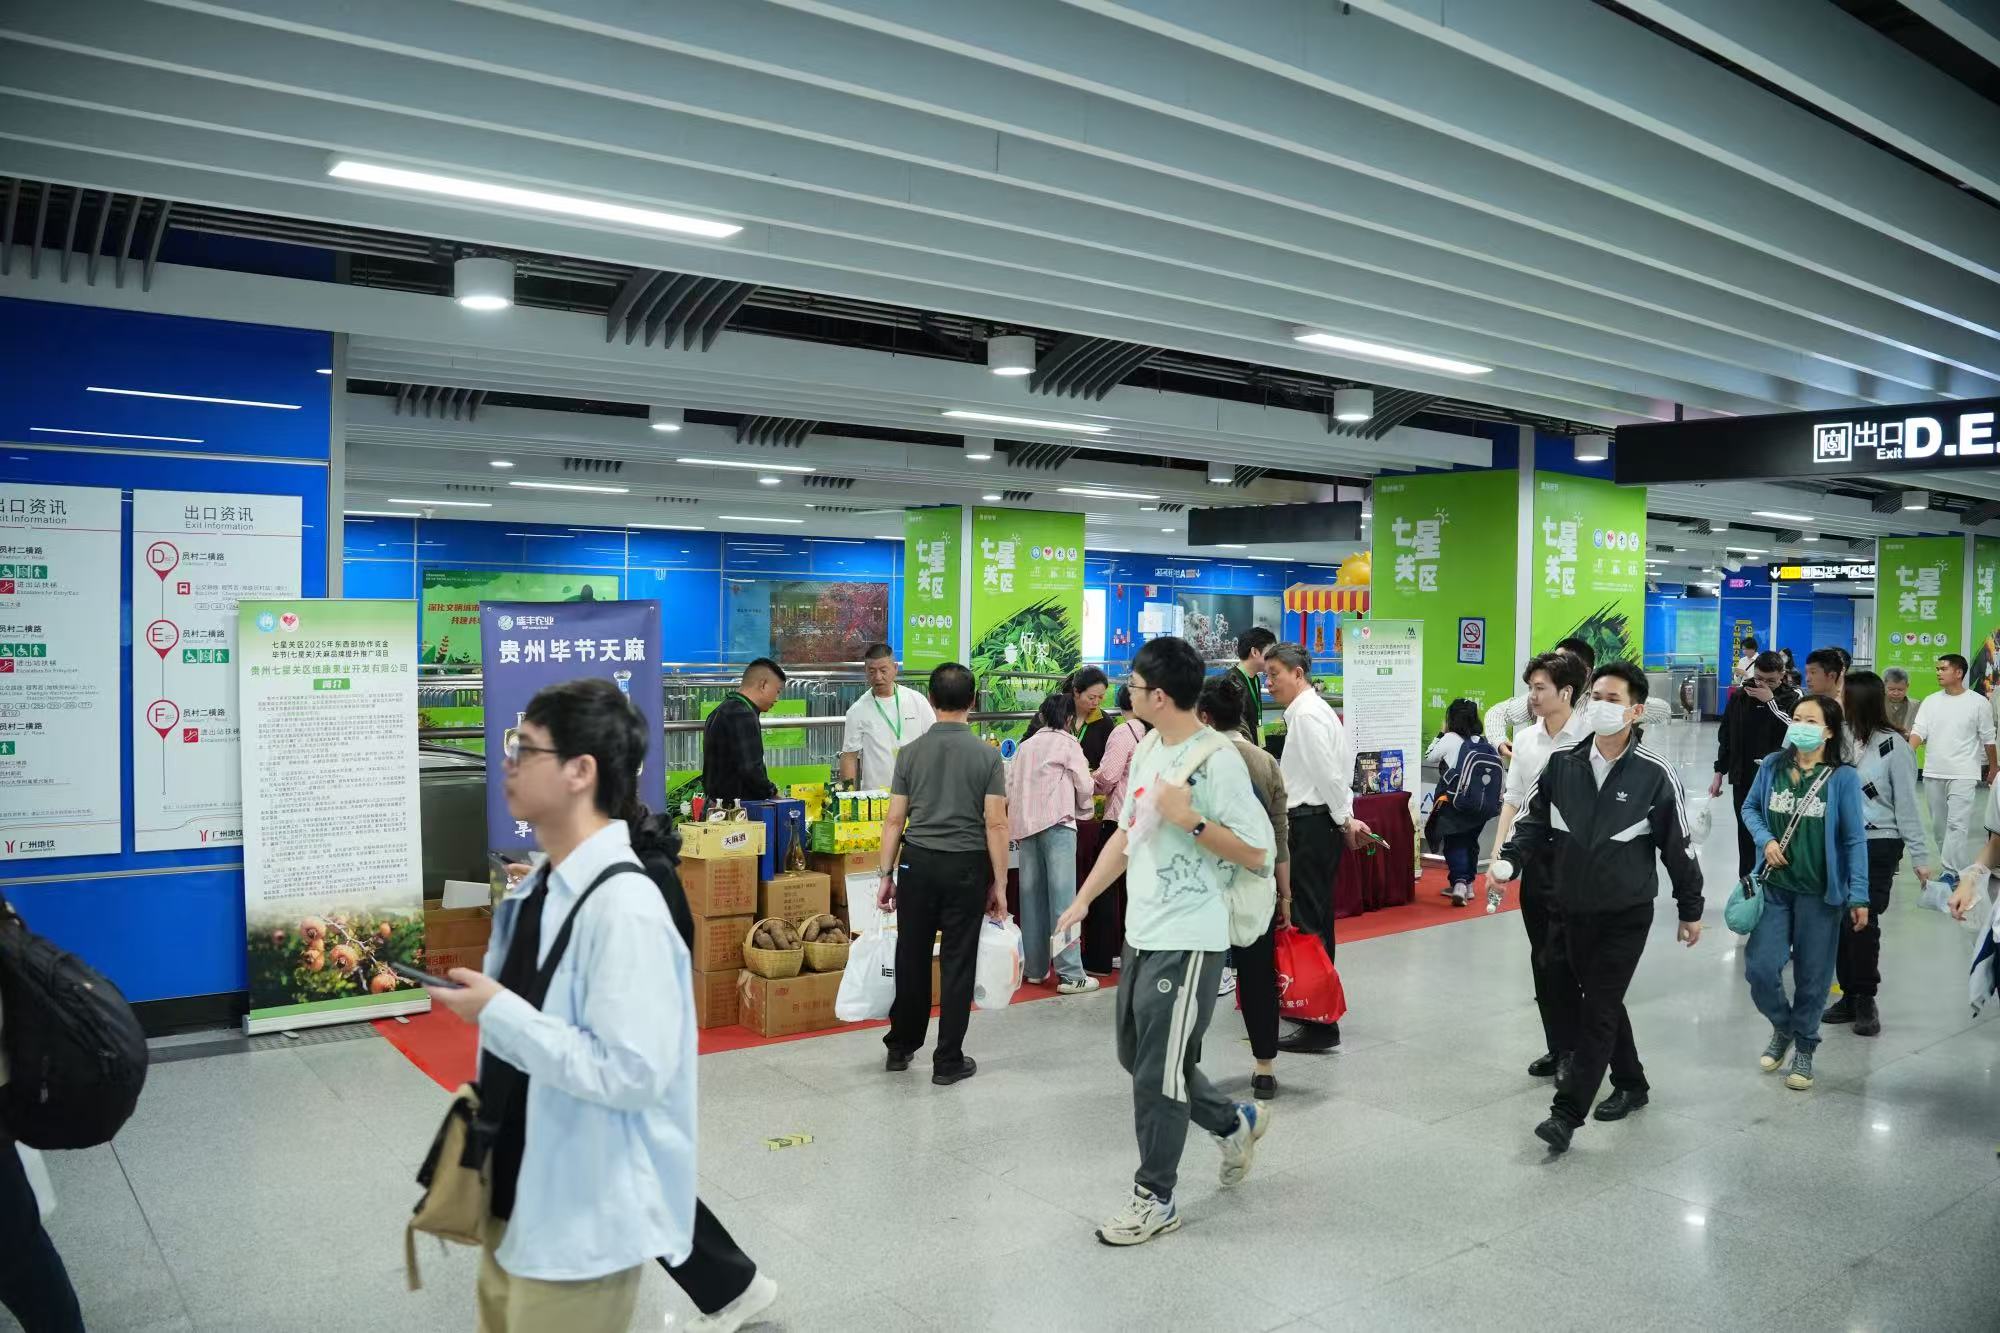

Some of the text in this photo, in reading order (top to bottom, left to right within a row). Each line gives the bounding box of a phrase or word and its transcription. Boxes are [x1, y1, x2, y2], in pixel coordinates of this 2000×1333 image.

[1855, 412, 2000, 459] 出口 D.E
[1876, 447, 1902, 460] Exit
[11, 514, 67, 524] Information
[184, 505, 254, 522] 出口资讯
[185, 521, 254, 531] Exit Information
[1392, 516, 1440, 560] 七星
[1542, 515, 1577, 562] 七星
[0, 546, 43, 555] 员村二横路
[152, 549, 165, 564] D
[182, 552, 225, 561] 员村二横路
[916, 540, 946, 573] 七星
[980, 537, 1016, 570] 七星
[1395, 554, 1438, 592] 关区
[1545, 554, 1576, 595] 关区
[1825, 565, 1848, 575] 卫生间
[917, 568, 944, 599] 关区
[983, 564, 1014, 593] 关区
[1896, 565, 1940, 596] 七星
[1899, 592, 1937, 621] 关区
[451, 616, 480, 625] 共建共
[516, 615, 555, 626] 盛丰农业
[0, 625, 42, 633] 员村二横路
[153, 628, 164, 642] E
[182, 629, 225, 638] 员村二横路
[272, 640, 389, 649] 七星关区2025年东西部协作资金
[498, 637, 646, 664] 贵州毕节天麻
[272, 650, 389, 659] 毕节(七星关)天麻品牌提升推广项目
[156, 708, 166, 722] F
[183, 709, 226, 718] 员村二横路
[0, 723, 42, 731] 员村二横路
[20, 840, 56, 849] 广州地铁
[724, 833, 747, 845] 天麻酒
